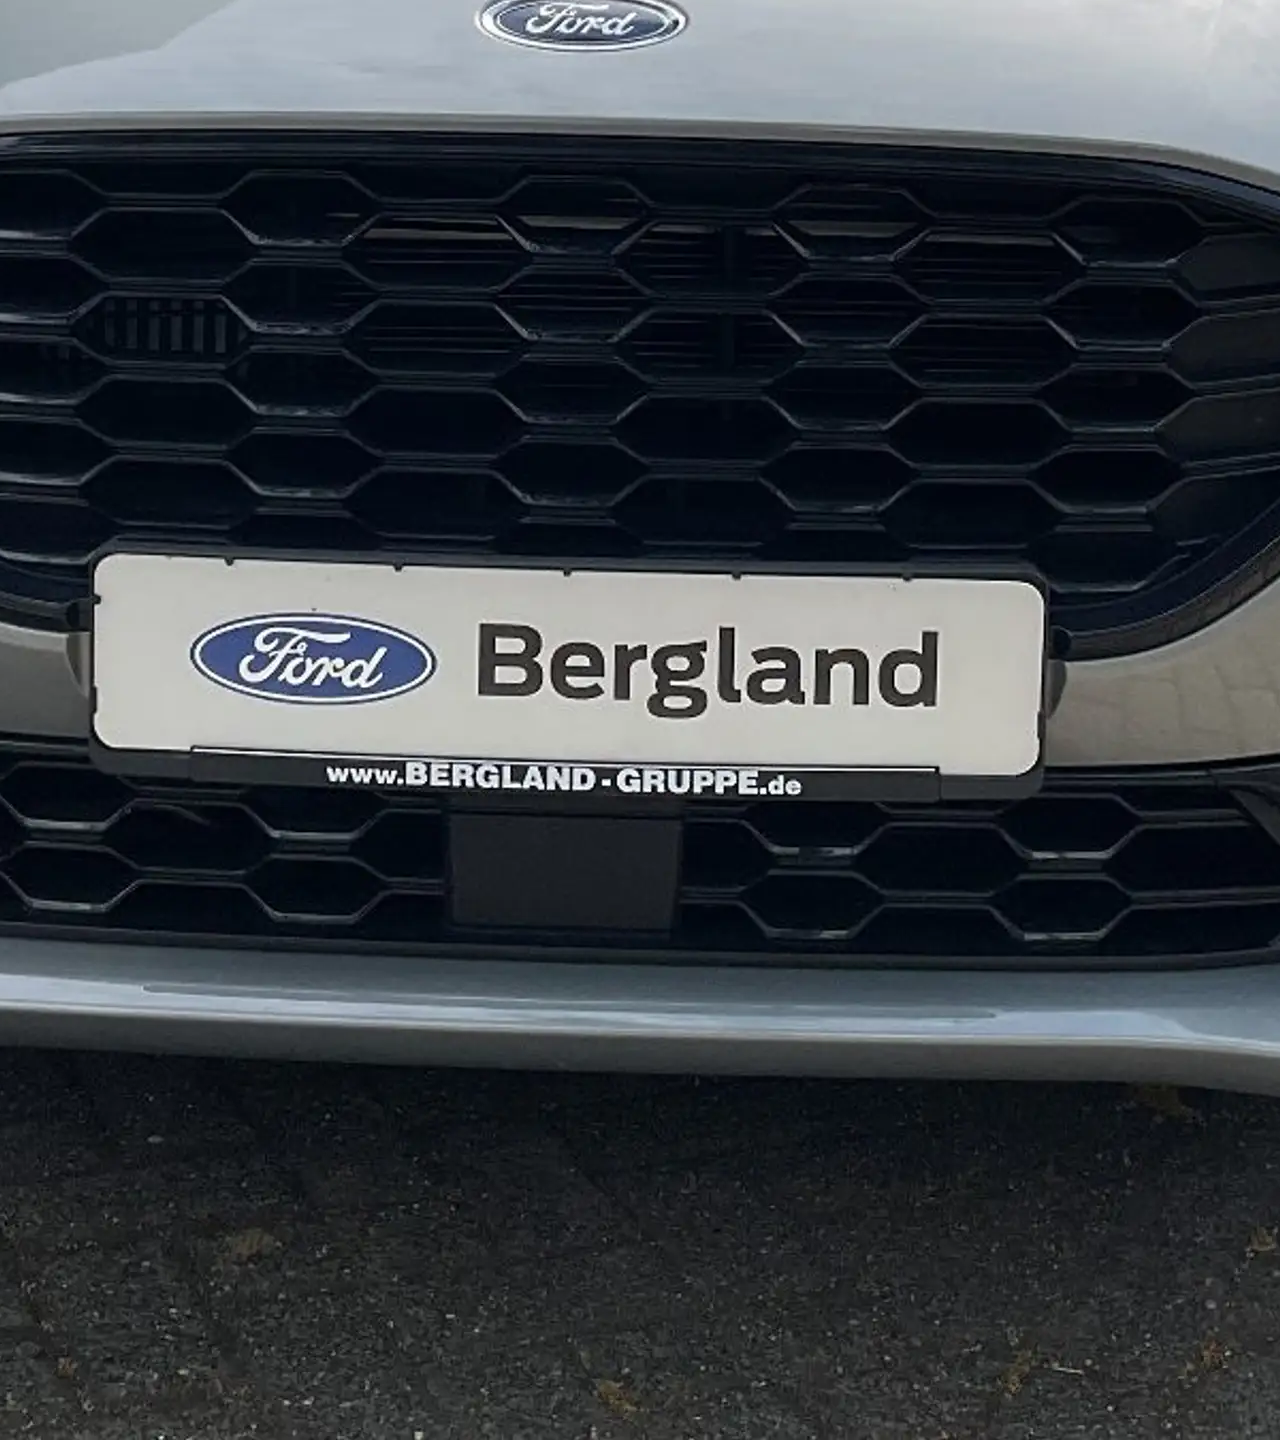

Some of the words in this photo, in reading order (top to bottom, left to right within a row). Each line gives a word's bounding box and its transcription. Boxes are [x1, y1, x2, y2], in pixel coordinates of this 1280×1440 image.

[524, 2, 640, 36] Ford
[238, 624, 387, 691] Ford
[477, 622, 940, 719] Bergland
